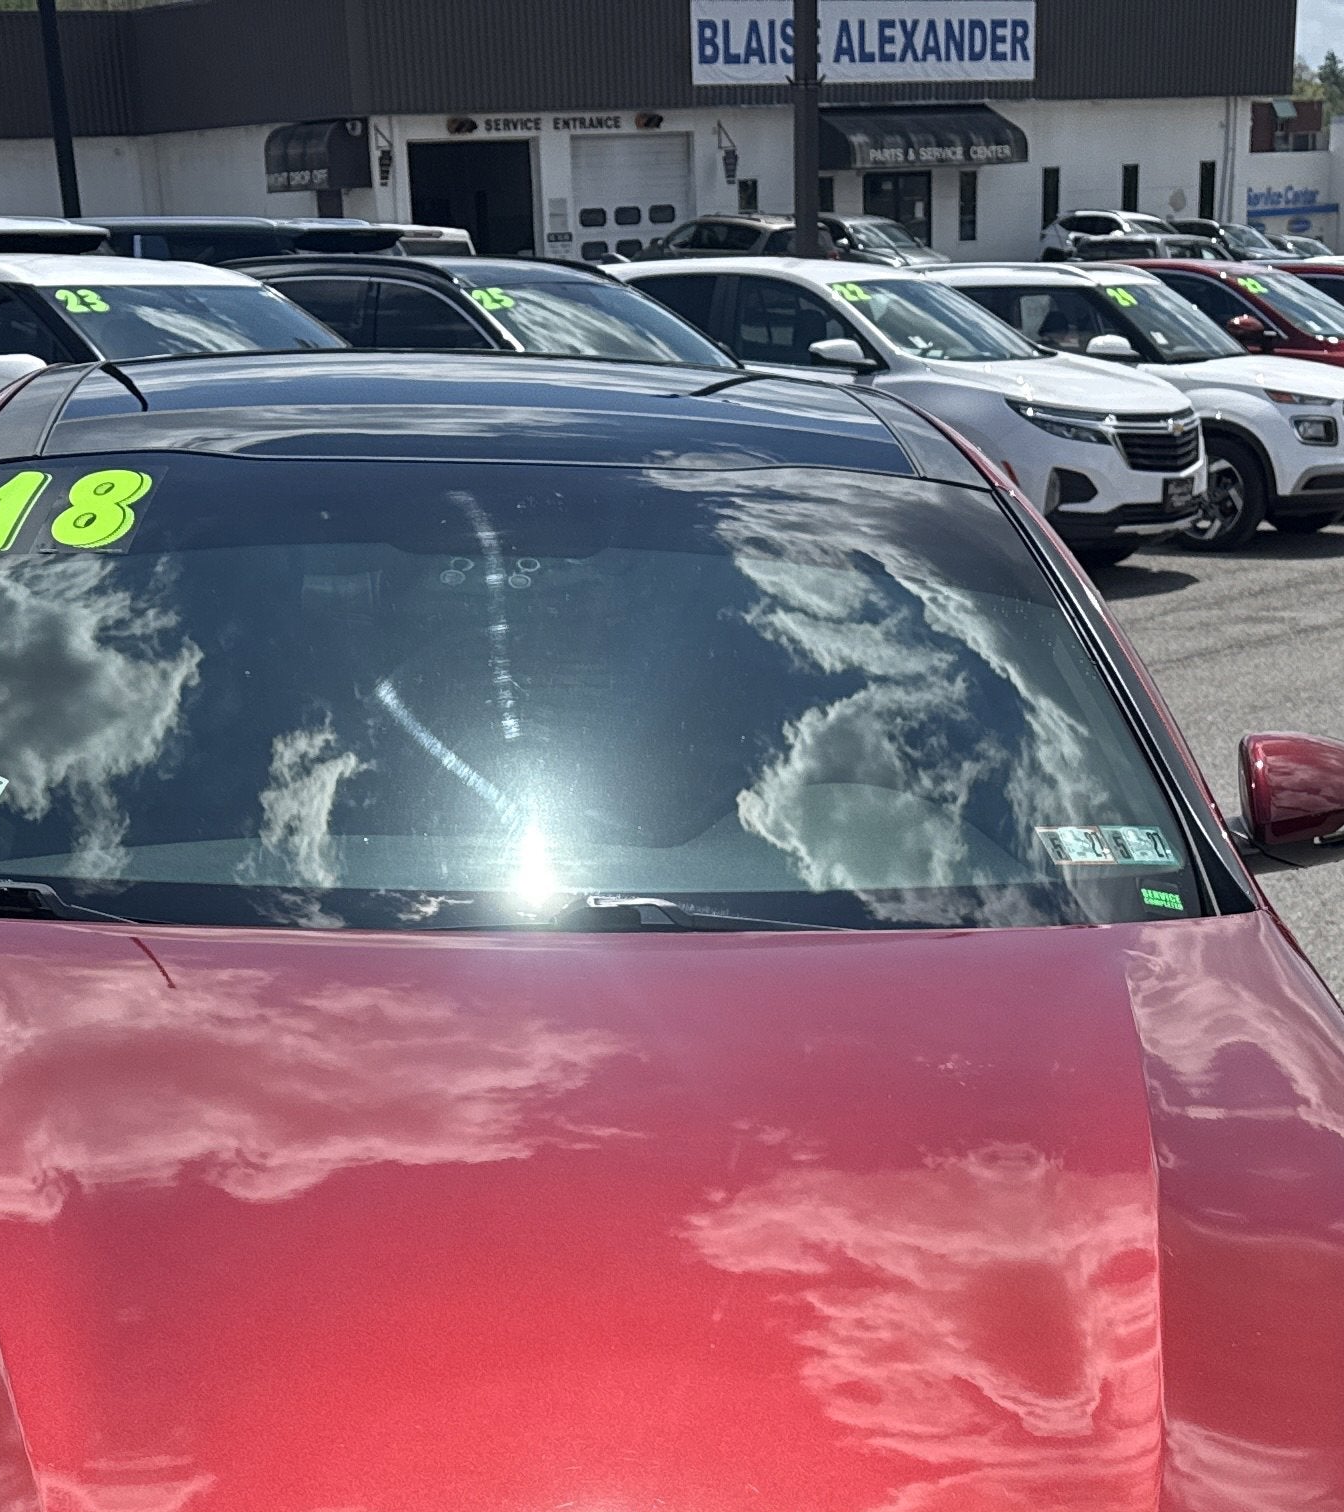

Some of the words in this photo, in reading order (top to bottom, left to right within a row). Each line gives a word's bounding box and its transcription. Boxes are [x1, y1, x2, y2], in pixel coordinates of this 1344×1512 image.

[697, 19, 822, 65] BLAIS
[833, 18, 1031, 63] ALEXANDER
[484, 117, 542, 132] SERVICE
[552, 115, 622, 130] ENTRANCE
[869, 149, 904, 161] PARTS
[969, 145, 1011, 160] CENTER
[55, 289, 110, 313] 23
[471, 287, 515, 310] 25
[832, 283, 873, 301] 22
[1141, 888, 1180, 904] SERVICE
